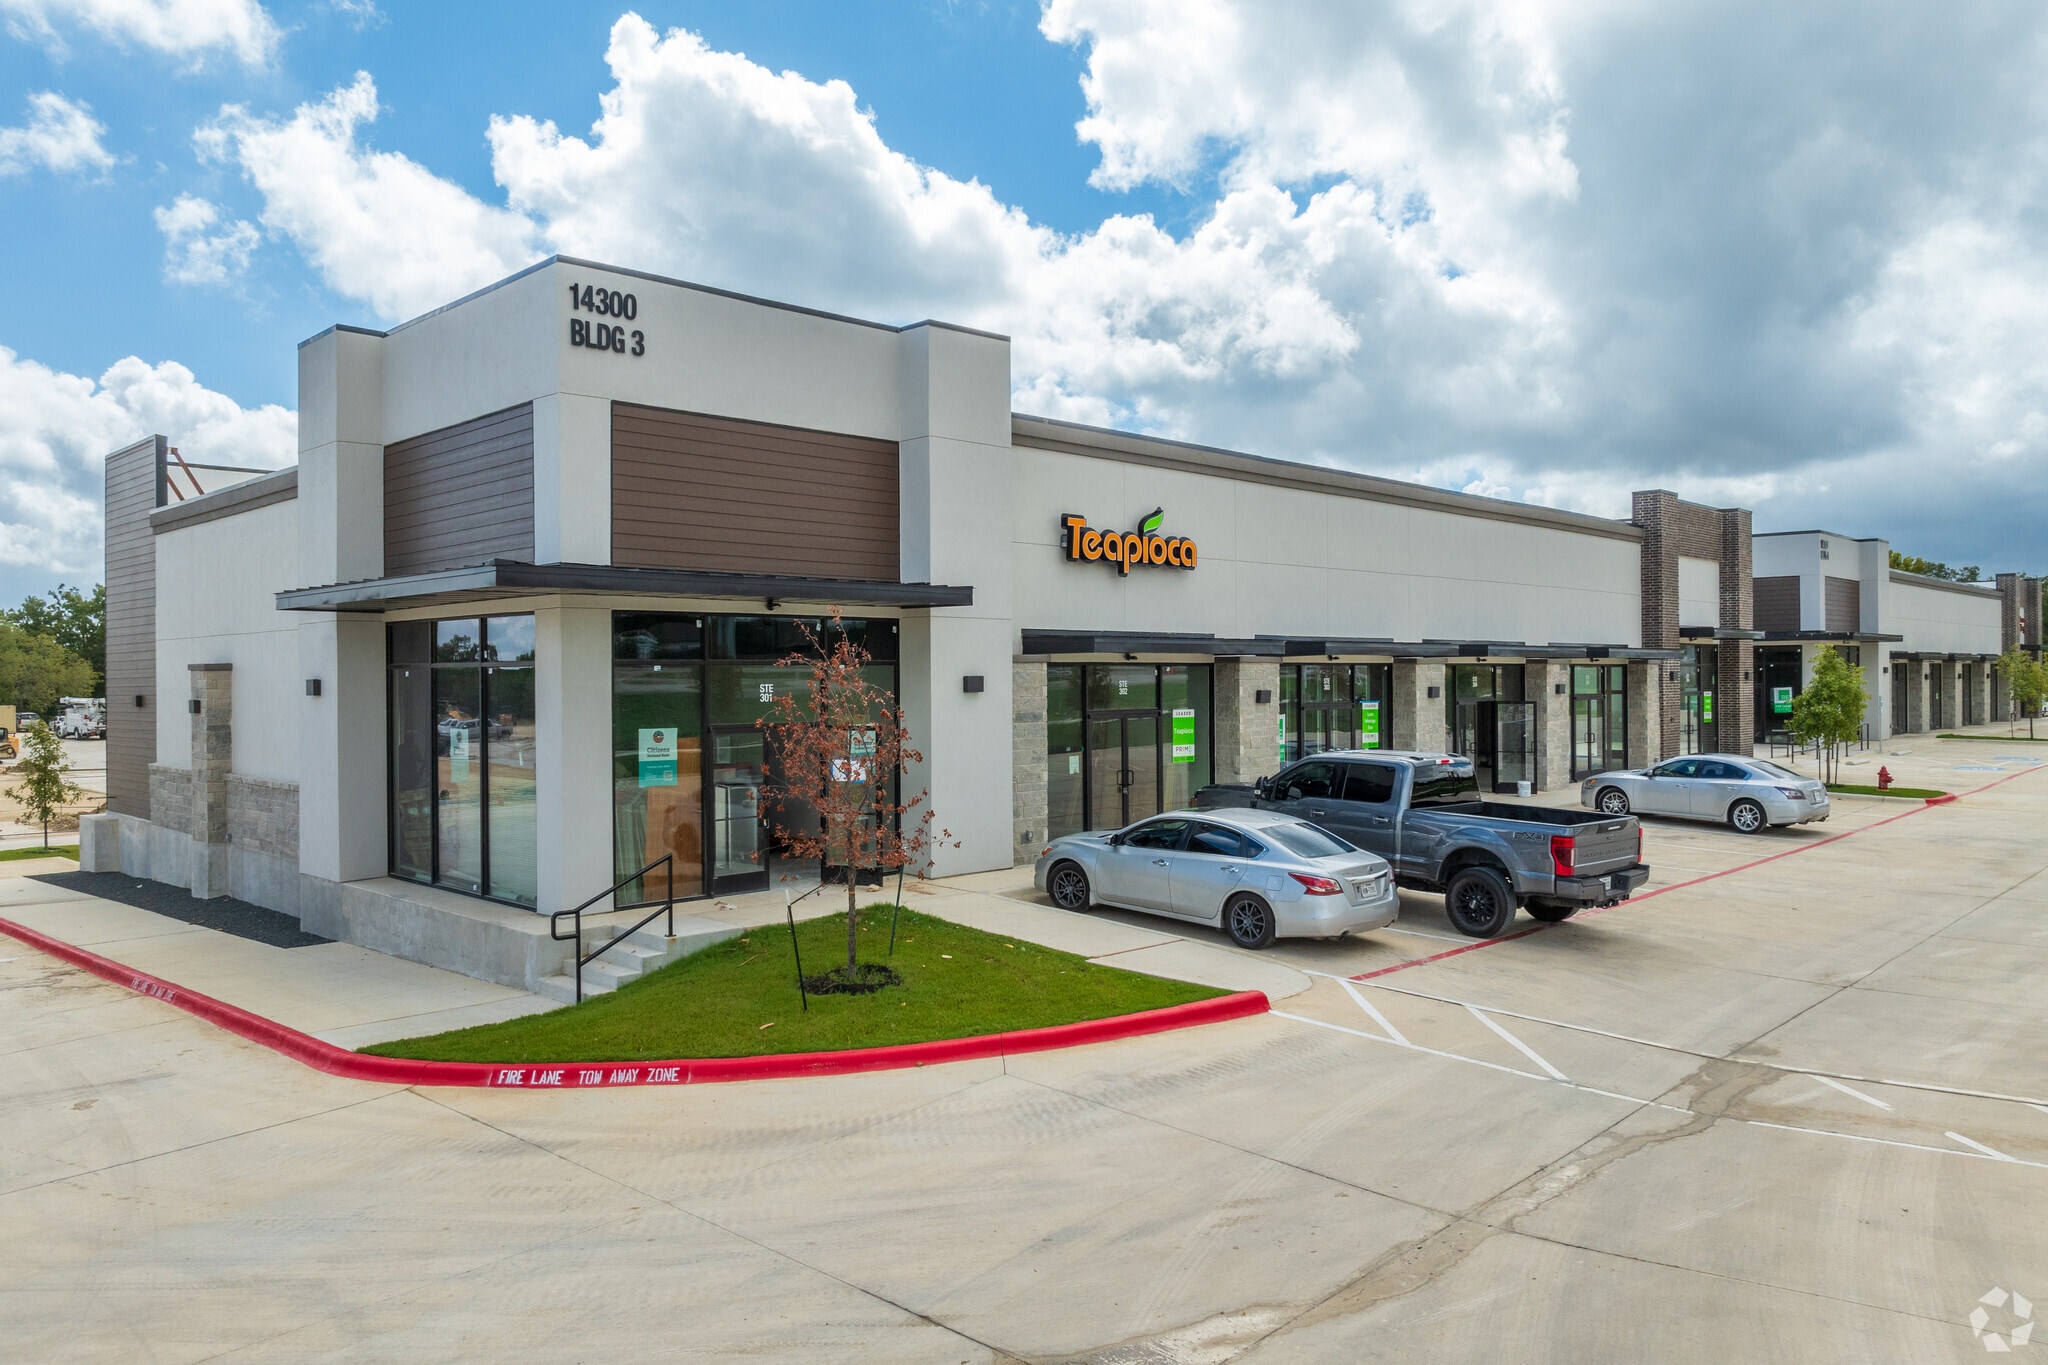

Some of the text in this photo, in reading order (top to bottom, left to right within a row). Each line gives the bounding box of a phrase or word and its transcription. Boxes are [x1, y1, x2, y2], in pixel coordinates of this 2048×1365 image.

[569, 283, 637, 320] 14300
[570, 318, 646, 357] BLDG 3
[1061, 511, 1198, 577] Teapioca
[760, 684, 773, 692] STE
[1119, 680, 1128, 688] STE
[760, 693, 772, 702] 301
[498, 1067, 681, 1085] FIRE LANE TOW AWAY ZONE
